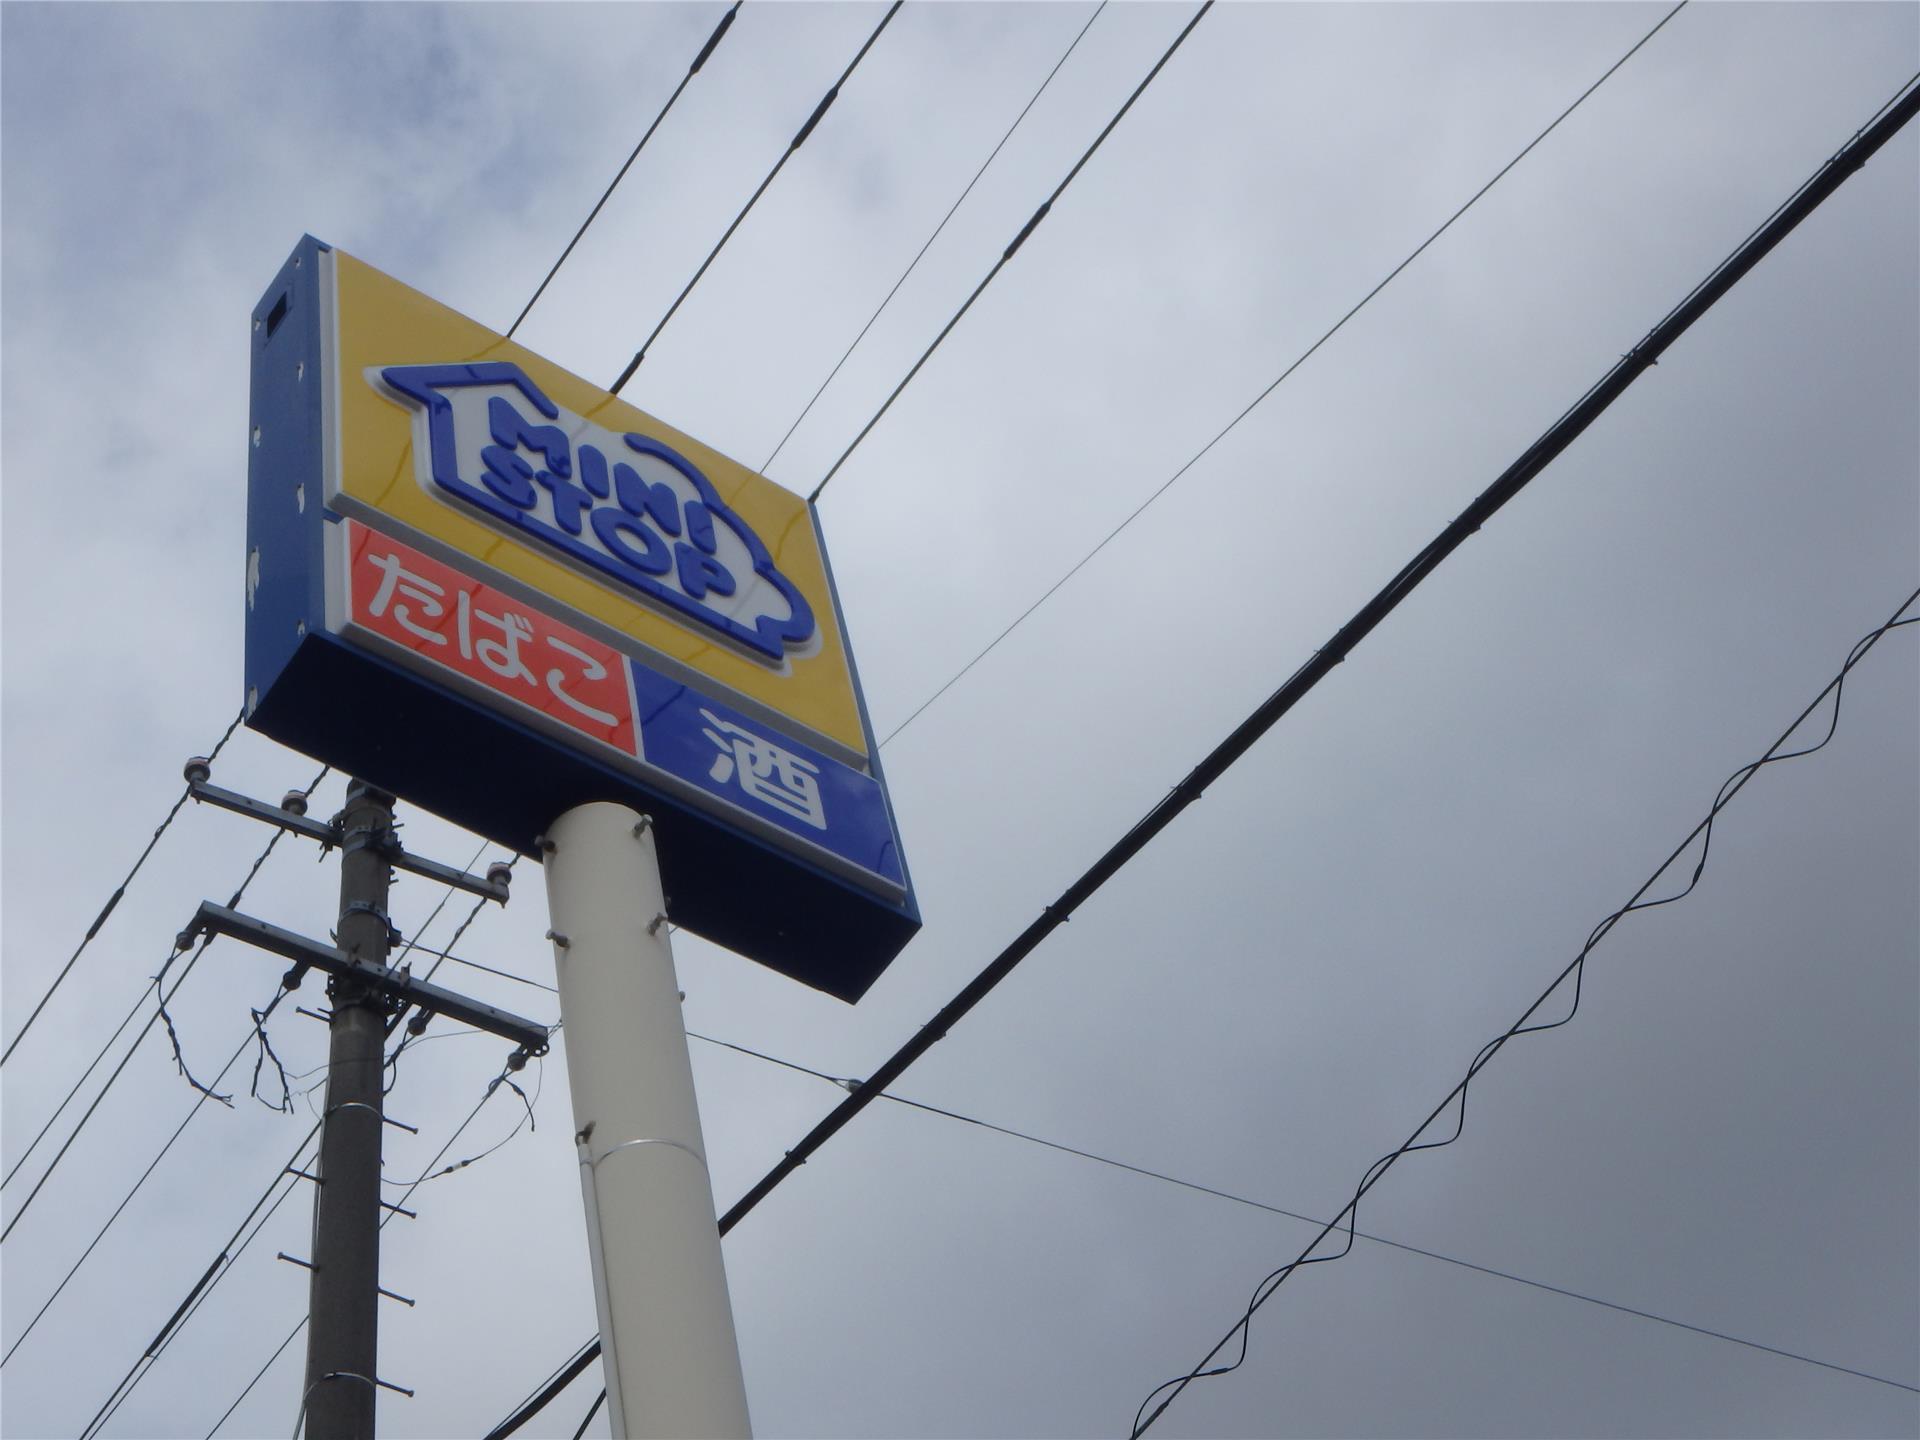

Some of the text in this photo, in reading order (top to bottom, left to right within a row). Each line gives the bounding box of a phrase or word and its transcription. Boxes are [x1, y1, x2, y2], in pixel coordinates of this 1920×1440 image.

[480, 444, 737, 600] STOP
[487, 396, 717, 555] MINI
[368, 553, 619, 727] たばこ
[699, 708, 828, 831] 酒
